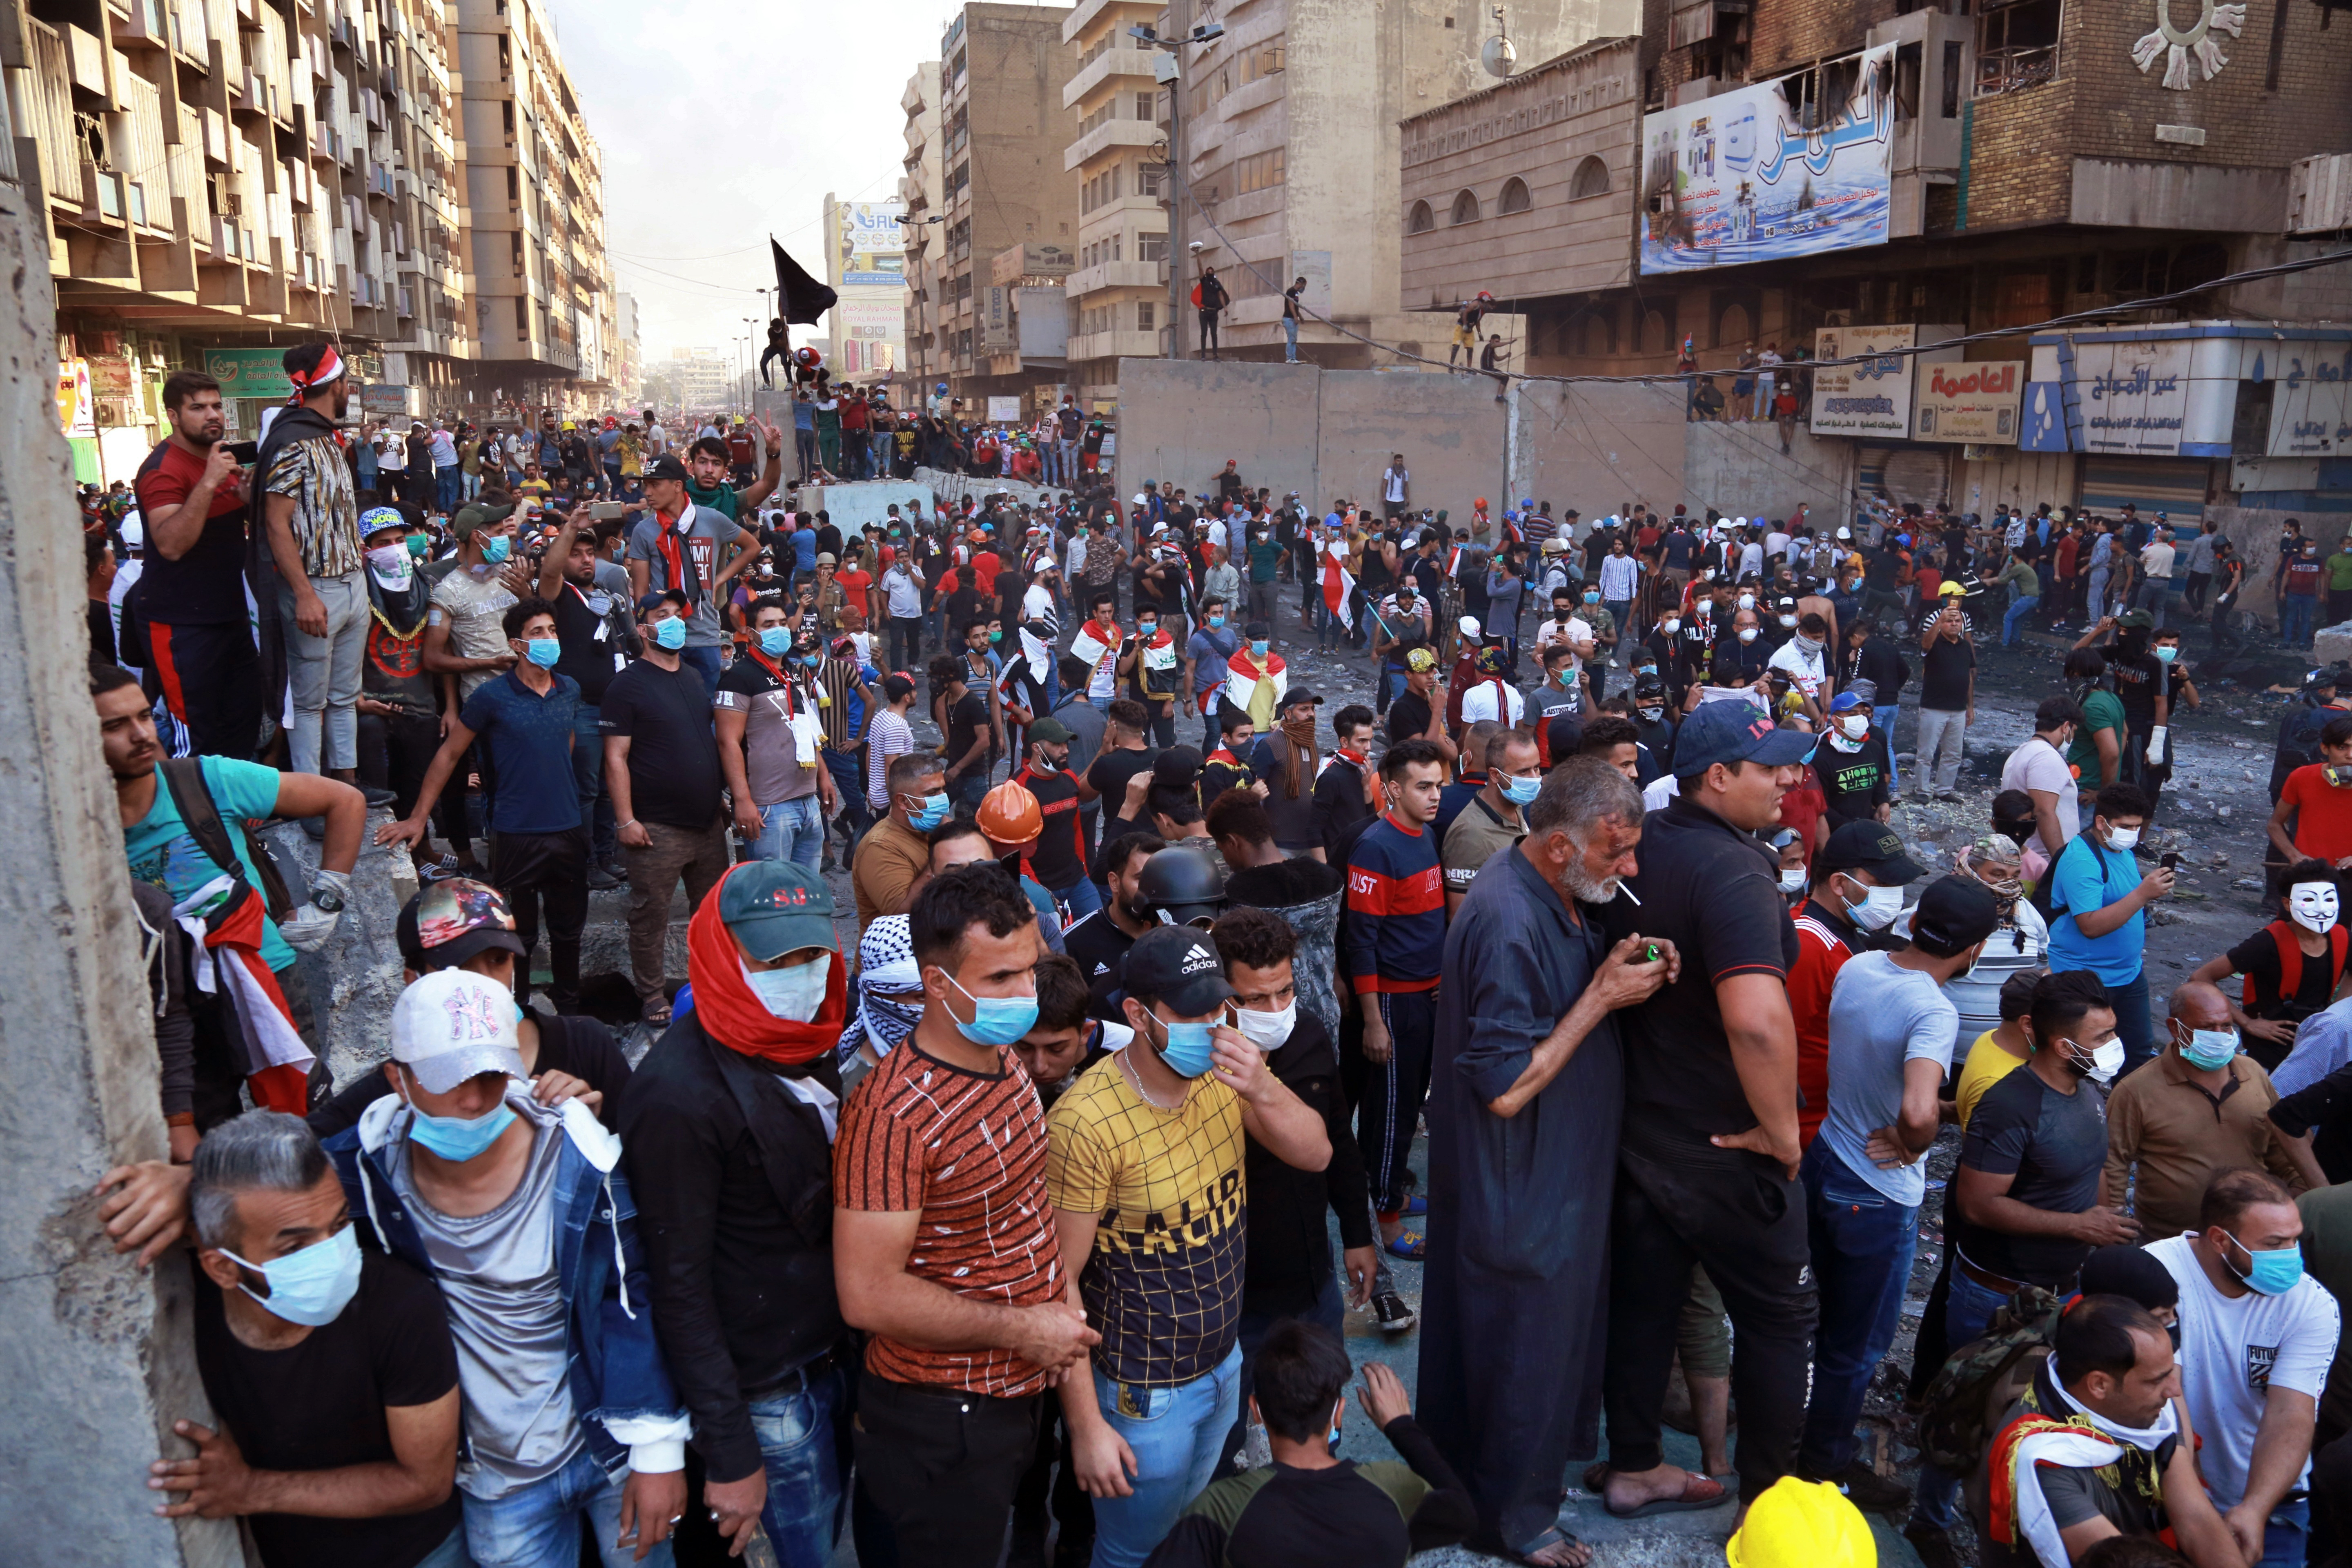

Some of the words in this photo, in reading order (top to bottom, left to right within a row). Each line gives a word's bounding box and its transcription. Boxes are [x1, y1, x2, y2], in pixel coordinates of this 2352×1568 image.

[1677, 192, 1695, 204] تصفي
[1859, 187, 1879, 202] الوكيل
[842, 304, 865, 314] الرحماني
[880, 304, 901, 313] منتجات
[241, 359, 277, 368] الرافدين
[1931, 366, 2015, 398] العاصمة
[2152, 374, 2177, 396] عبر
[895, 432, 915, 444] YOUTH
[1043, 799, 1078, 814] BOMBERS
[1349, 872, 1377, 895] JUST
[773, 888, 807, 908] SJ
[1181, 959, 1218, 974] adidas
[1097, 1169, 1246, 1256] KALIB
